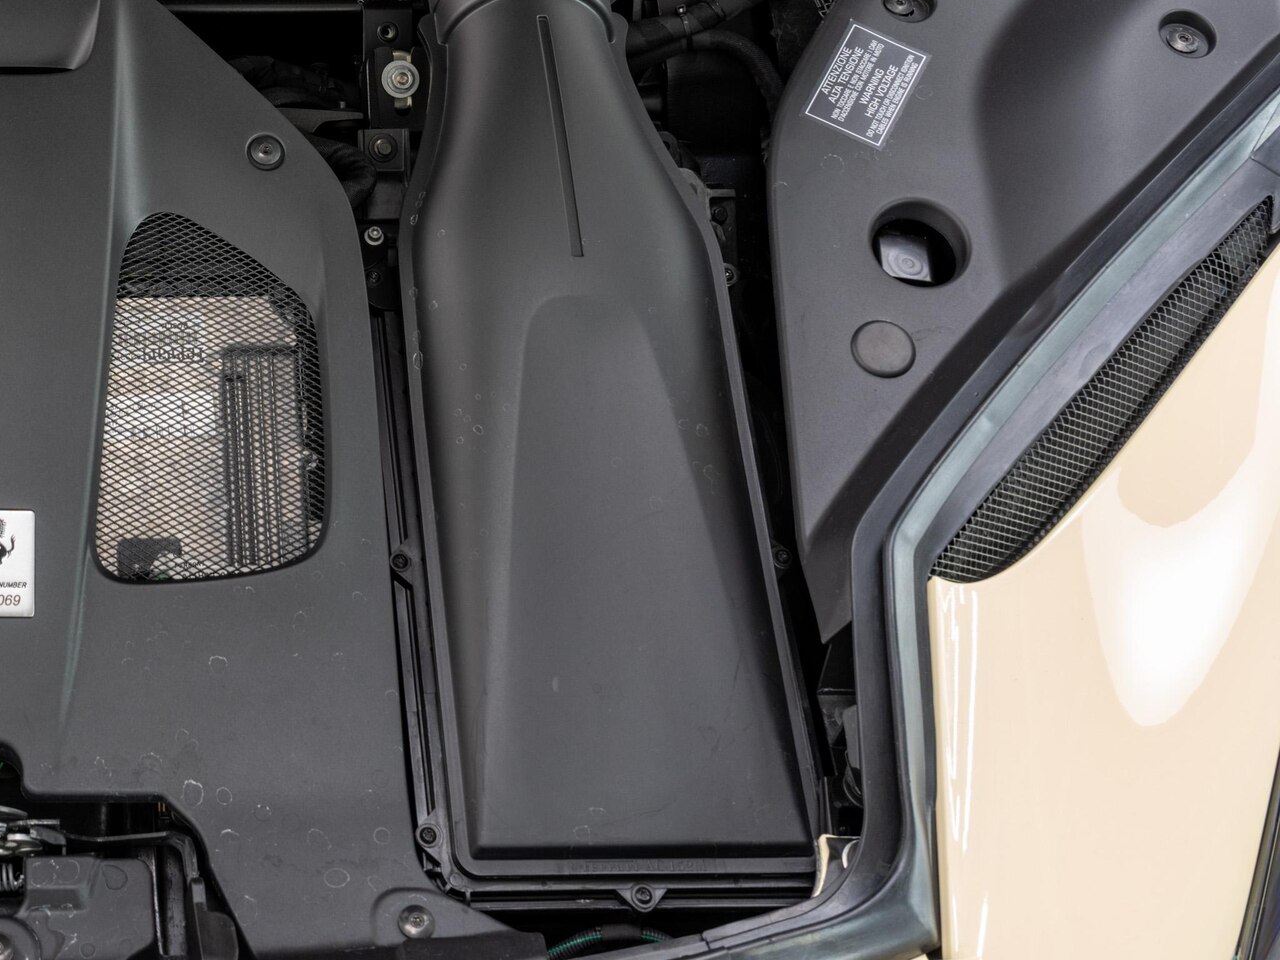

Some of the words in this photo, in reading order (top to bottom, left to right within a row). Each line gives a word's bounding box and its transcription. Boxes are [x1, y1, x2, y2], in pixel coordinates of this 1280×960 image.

[820, 46, 852, 94] ATTENZIONE
[827, 83, 843, 103] ALTA
[837, 46, 864, 85] TENSIONE
[830, 107, 841, 119] NON
[836, 88, 852, 108] TOCCARE
[849, 73, 859, 85] NON
[855, 52, 871, 74] STACCARE
[868, 39, 878, 50] CAVI
[854, 80, 864, 91] CON
[859, 61, 874, 80] MOTORE
[872, 42, 884, 57] MOTO
[858, 67, 884, 105] WARNING
[864, 96, 881, 117] HIGH
[875, 64, 898, 97] VOLTAGE
[870, 119, 879, 130] NOT
[875, 104, 887, 120] TOUCH
[886, 71, 904, 99] DISCONNECT
[900, 53, 914, 73] IGNITION
[875, 117, 889, 134] CABLES
[884, 103, 896, 117] WHEN
[892, 87, 905, 103] ENGINE
[903, 61, 918, 82] RUNNING
